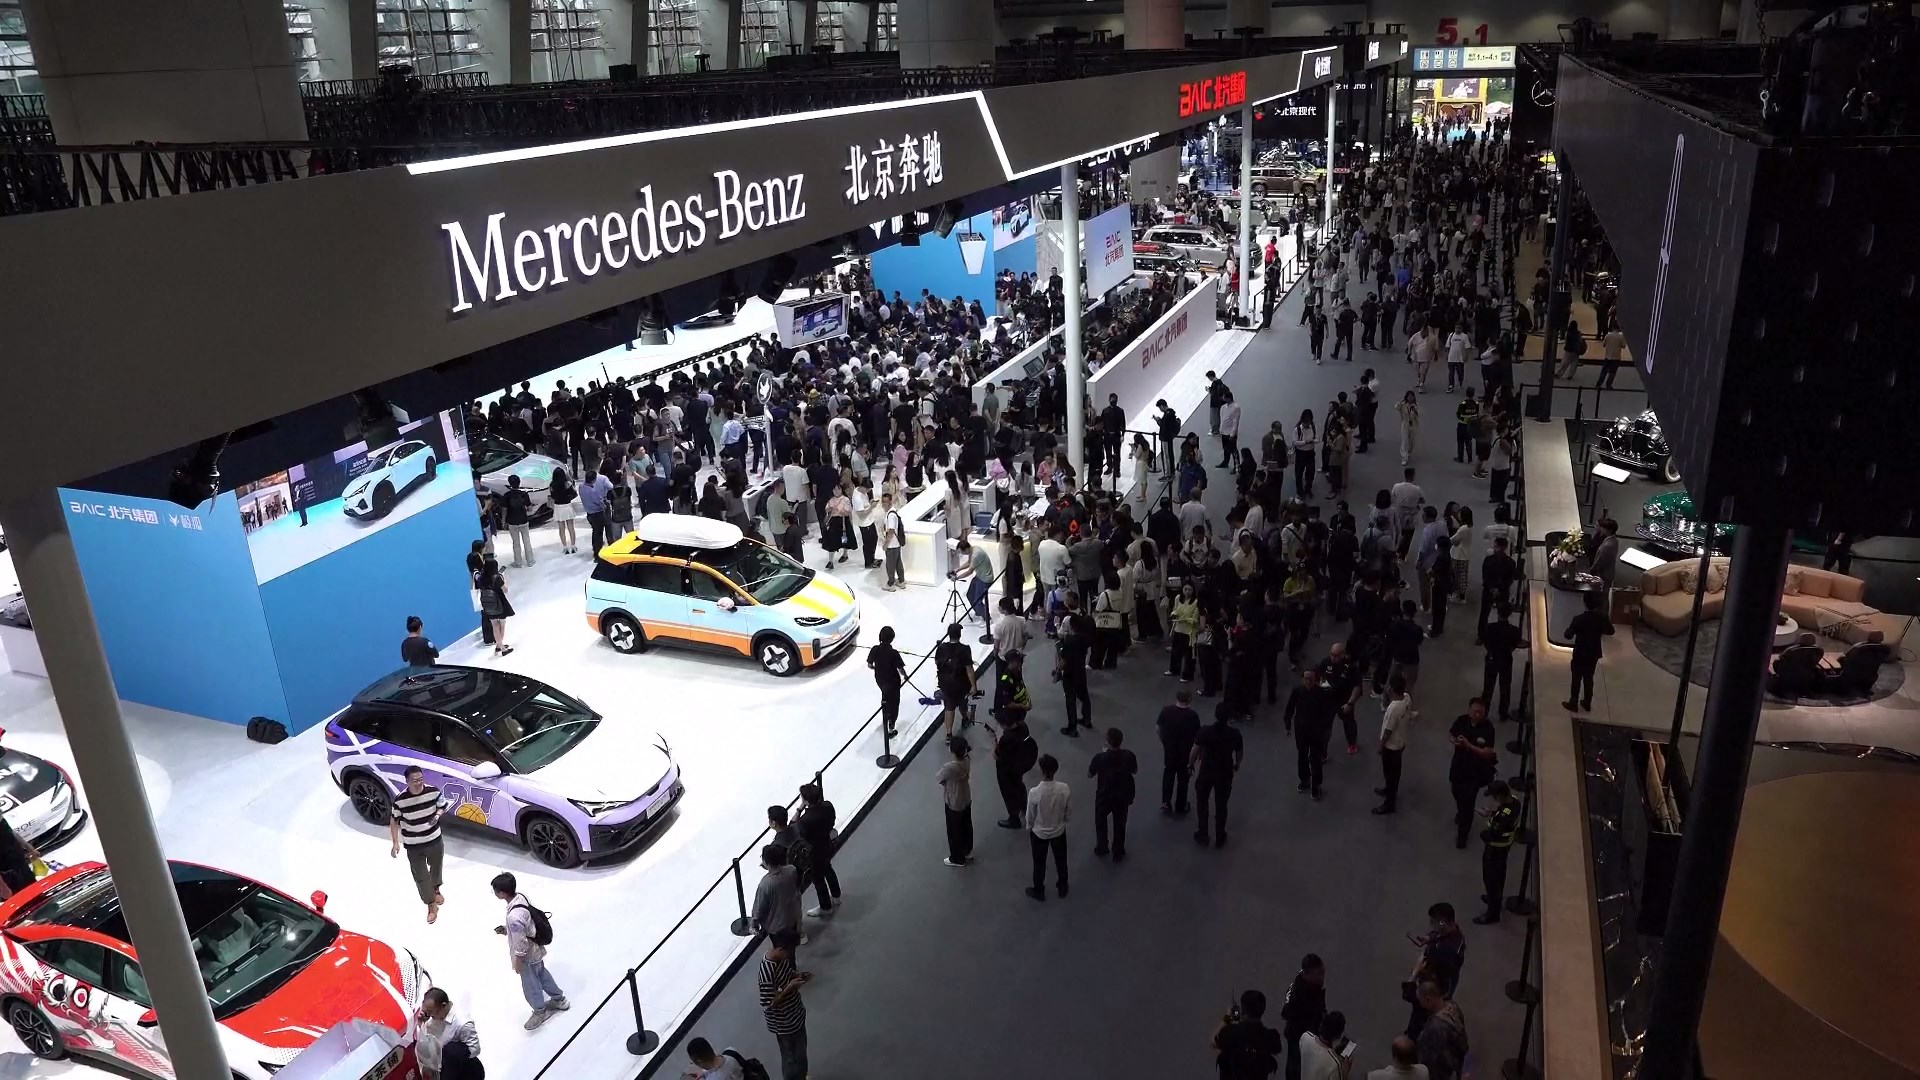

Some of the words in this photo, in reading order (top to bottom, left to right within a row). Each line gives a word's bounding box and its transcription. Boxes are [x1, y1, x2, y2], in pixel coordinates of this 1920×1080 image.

[1436, 17, 1488, 45] 5.1
[1180, 79, 1213, 118] BAIC
[1213, 71, 1246, 111] 北汽集团
[441, 170, 806, 313] Mercedes-Benz
[845, 130, 943, 205] 北京奔驰
[70, 501, 106, 517] BAIC
[107, 505, 159, 525] 北汽集团
